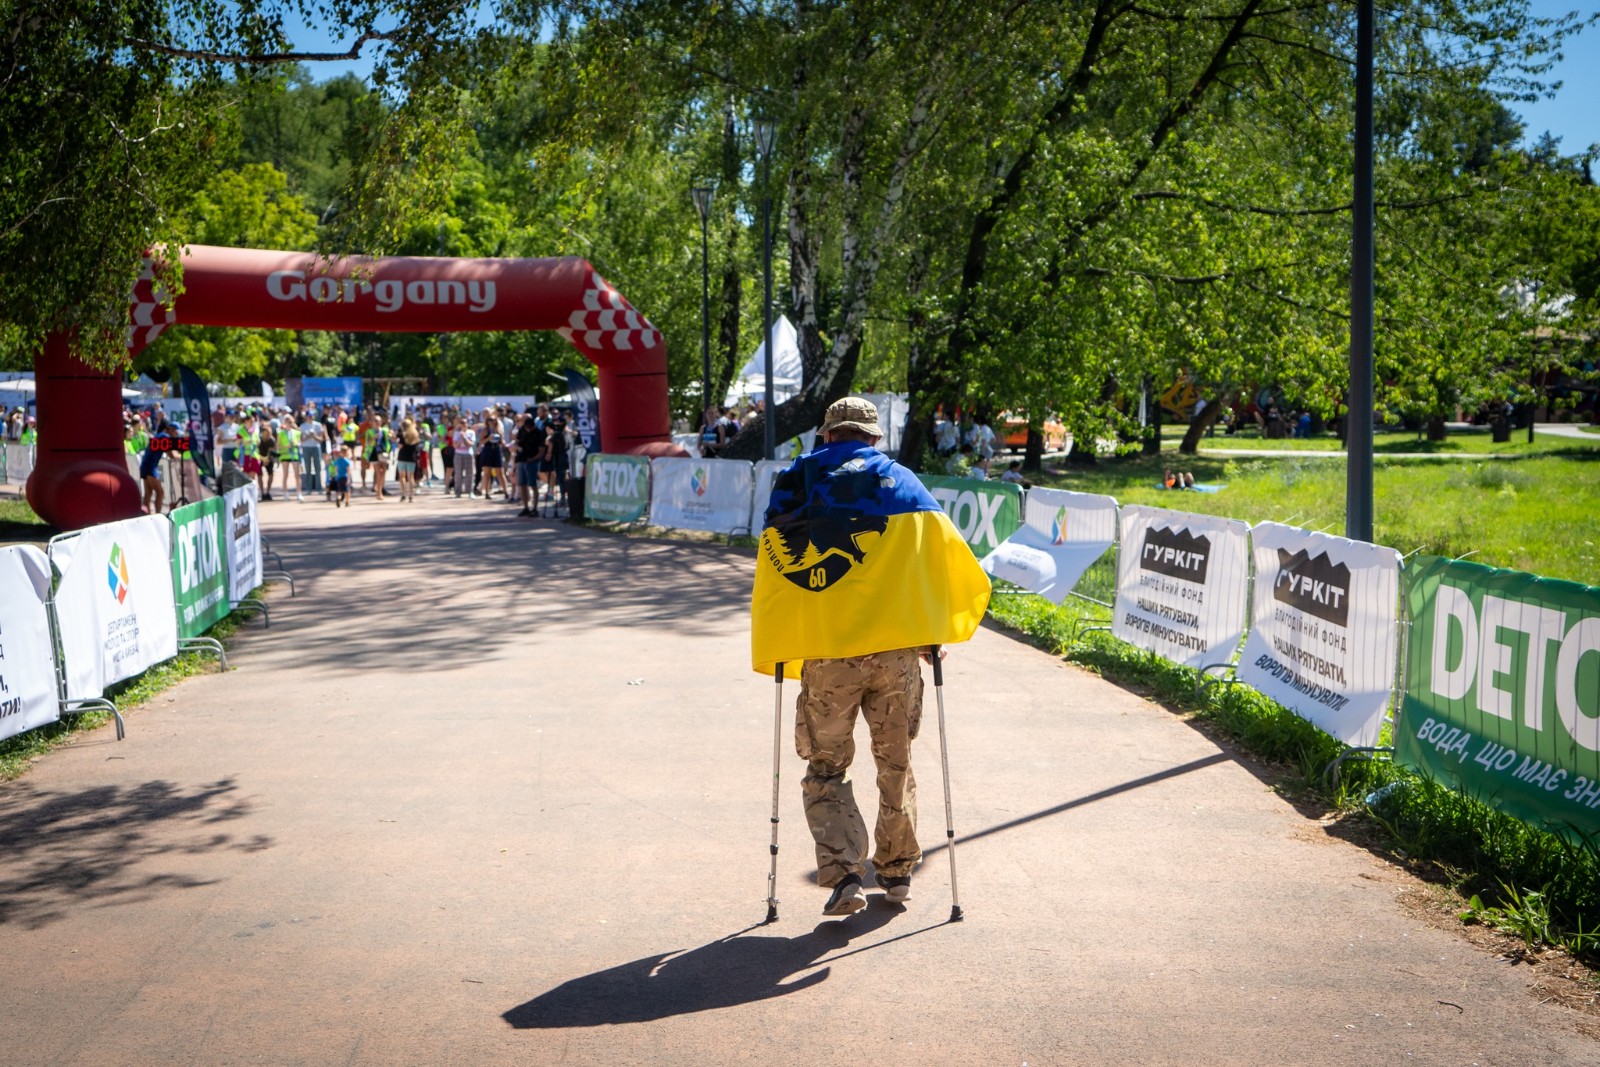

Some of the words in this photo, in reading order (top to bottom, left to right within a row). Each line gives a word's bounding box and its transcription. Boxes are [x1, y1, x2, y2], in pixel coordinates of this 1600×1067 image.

[266, 270, 497, 313] Gorgany
[592, 462, 642, 498] DETOX
[930, 487, 1006, 548] TOX
[178, 512, 222, 594] DETOX
[1143, 543, 1204, 571] ГУРКІТ
[809, 567, 827, 588] 60
[1182, 588, 1204, 605] ФОНД
[1276, 569, 1345, 609] ГУРКІТ
[1136, 597, 1159, 615] НАШИХ
[1160, 605, 1200, 632] РЯТУВАТИ,
[1275, 608, 1319, 640] БЛАГОДІЙНИЙ
[1322, 630, 1347, 654] ФОНД
[1150, 622, 1208, 654] МІНУСУВАТИ!
[1273, 634, 1298, 662] НАШИХ
[1298, 648, 1347, 688] РЯТУВАТИ,
[1254, 654, 1294, 684] ВОРОГІВ
[1290, 672, 1350, 711] МІНУСУВАТИ!
[1417, 717, 1471, 763] ВОДА,
[1474, 741, 1516, 772] ЩО
[1512, 756, 1567, 792] МАЄ
